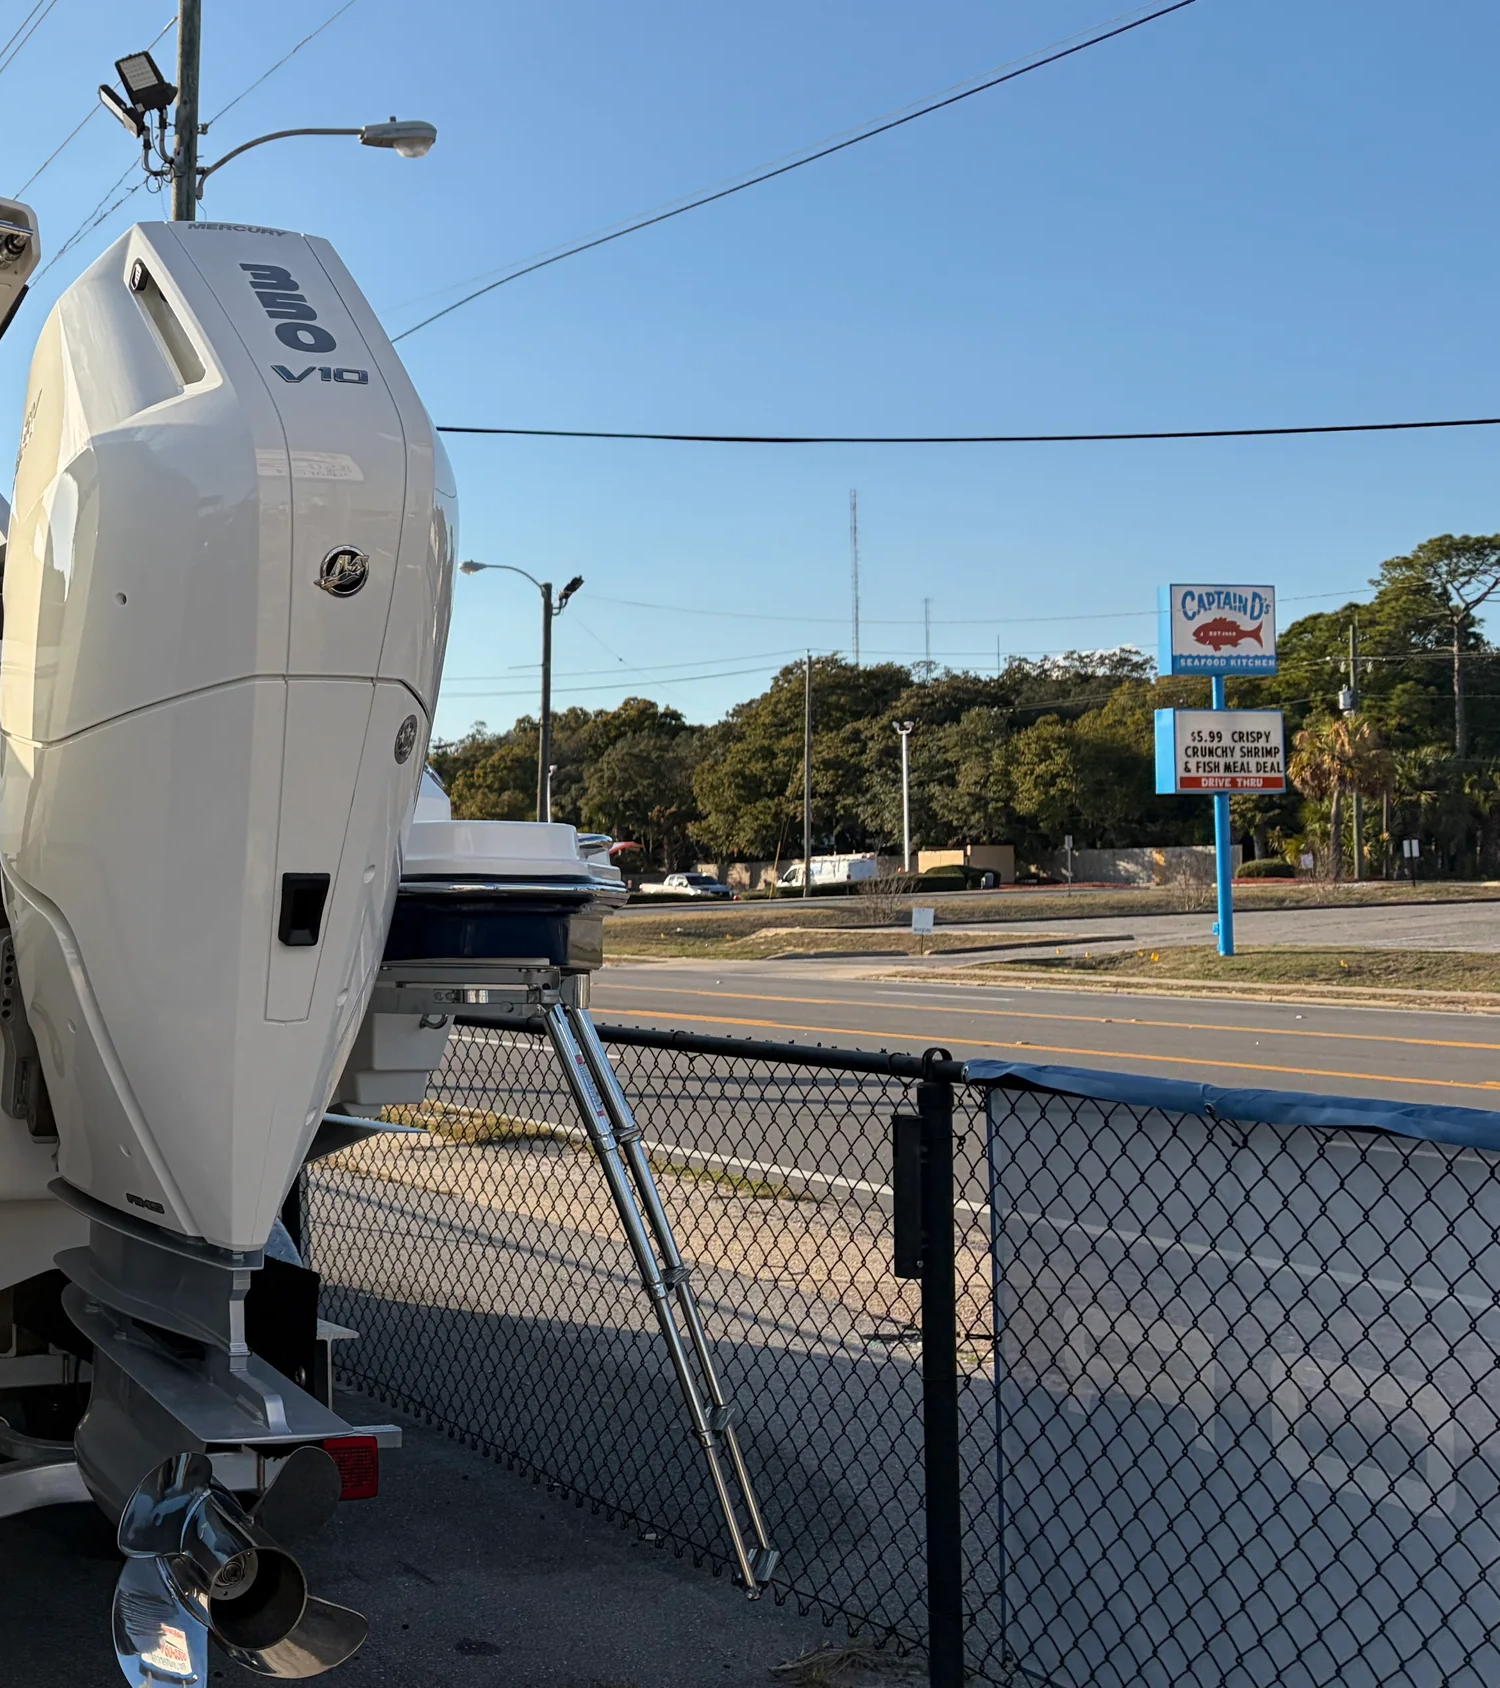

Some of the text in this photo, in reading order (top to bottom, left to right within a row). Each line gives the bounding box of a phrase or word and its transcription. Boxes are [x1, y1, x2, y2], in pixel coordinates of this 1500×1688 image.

[187, 222, 287, 238] MERCURY
[239, 262, 337, 354] 350
[270, 364, 369, 385] V10
[1181, 590, 1249, 621] CAPTAIN
[1180, 656, 1276, 668] SEAFOOD KITCHEN
[1190, 730, 1271, 744] $5.99 CRISPY
[1184, 745, 1280, 759] CRUNCHY SHRIMP
[1183, 761, 1283, 774] & FISH MEAL DEAL
[1201, 777, 1263, 788] DRIVE THRU
